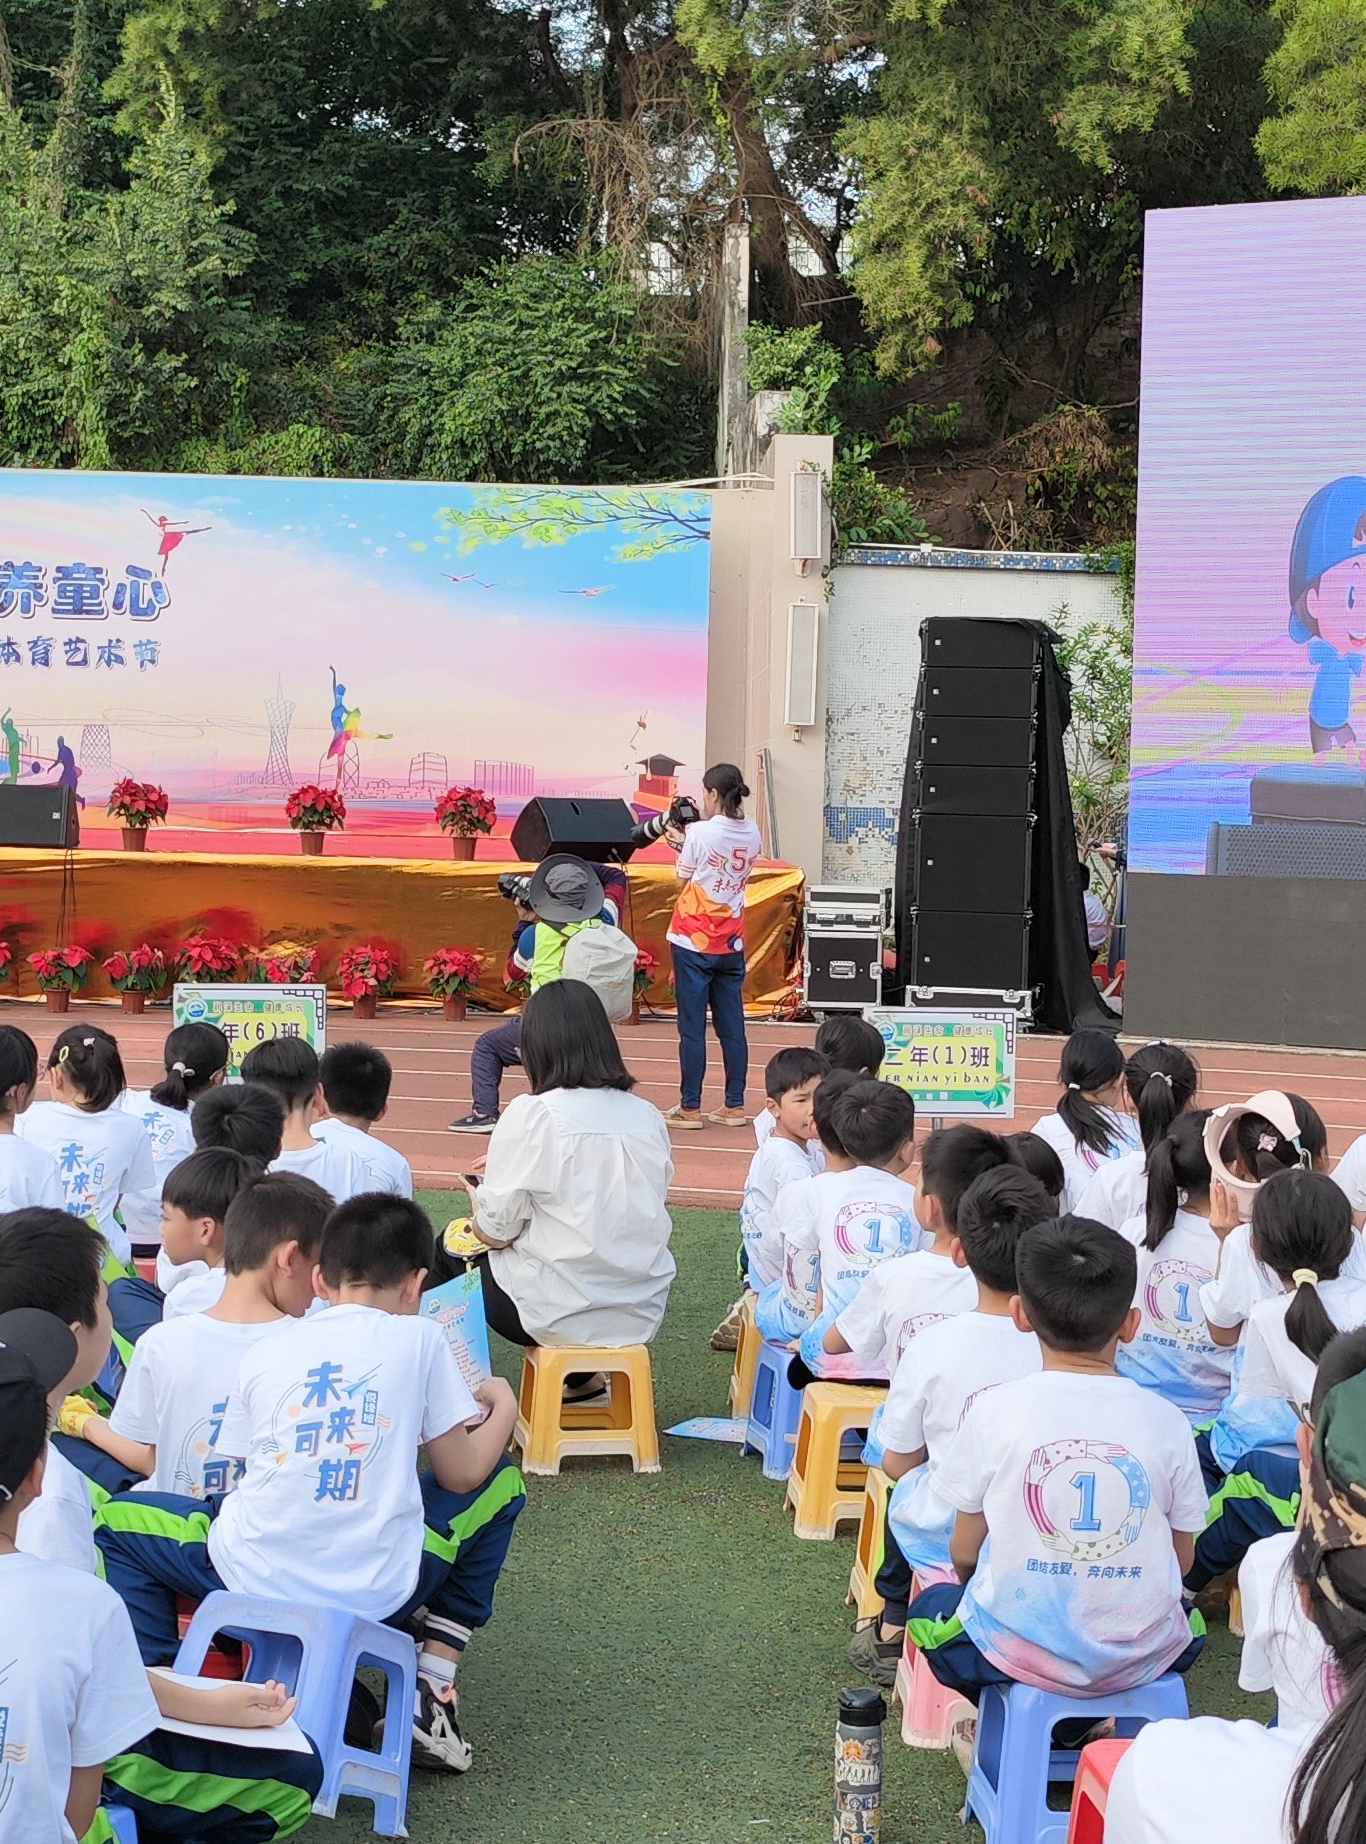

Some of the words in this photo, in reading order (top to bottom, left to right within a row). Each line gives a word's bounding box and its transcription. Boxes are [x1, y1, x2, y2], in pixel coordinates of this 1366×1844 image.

[731, 846, 749, 873] 5
[220, 1021, 302, 1044] 年(6)班
[884, 1045, 991, 1068] 二年(1)班
[863, 1217, 885, 1254] 1
[1173, 1281, 1193, 1322] 1
[1068, 1471, 1102, 1532] 1
